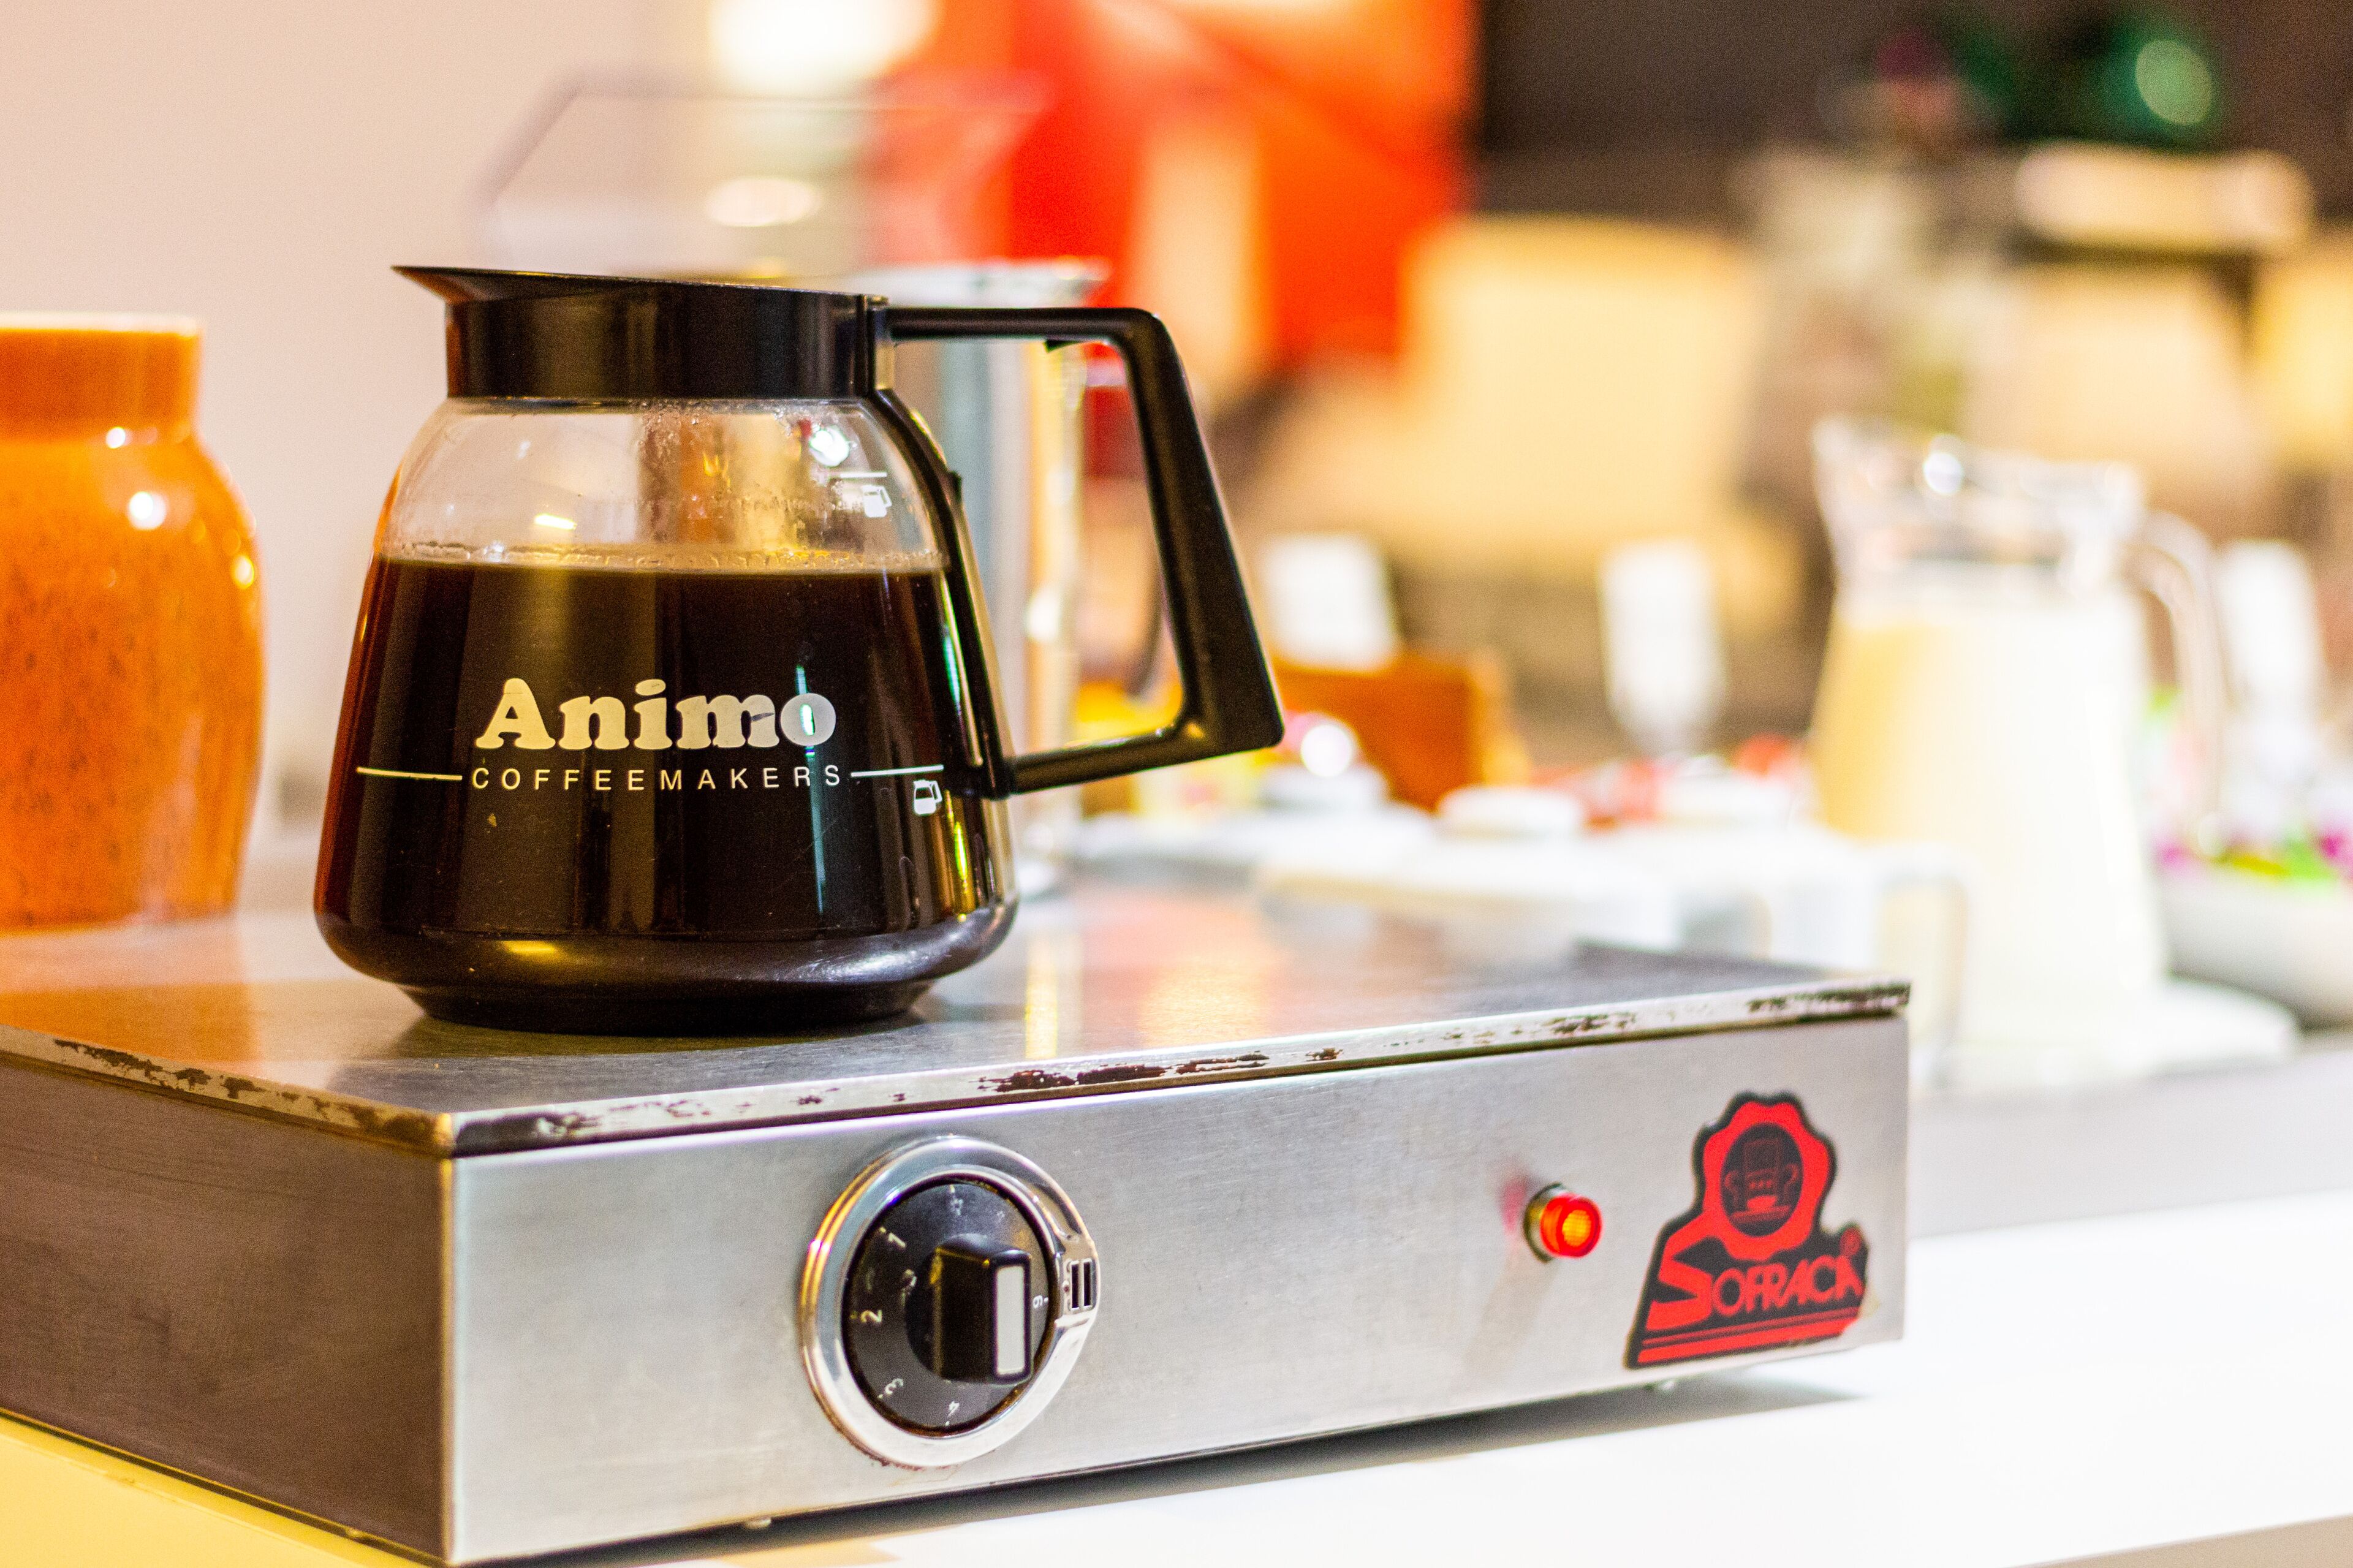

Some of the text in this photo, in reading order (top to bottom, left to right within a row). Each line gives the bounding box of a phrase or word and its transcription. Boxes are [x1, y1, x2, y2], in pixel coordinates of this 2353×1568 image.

[474, 677, 837, 751] Animo
[471, 764, 841, 791] COFFEEMAKERS
[860, 1309, 883, 1324] 2
